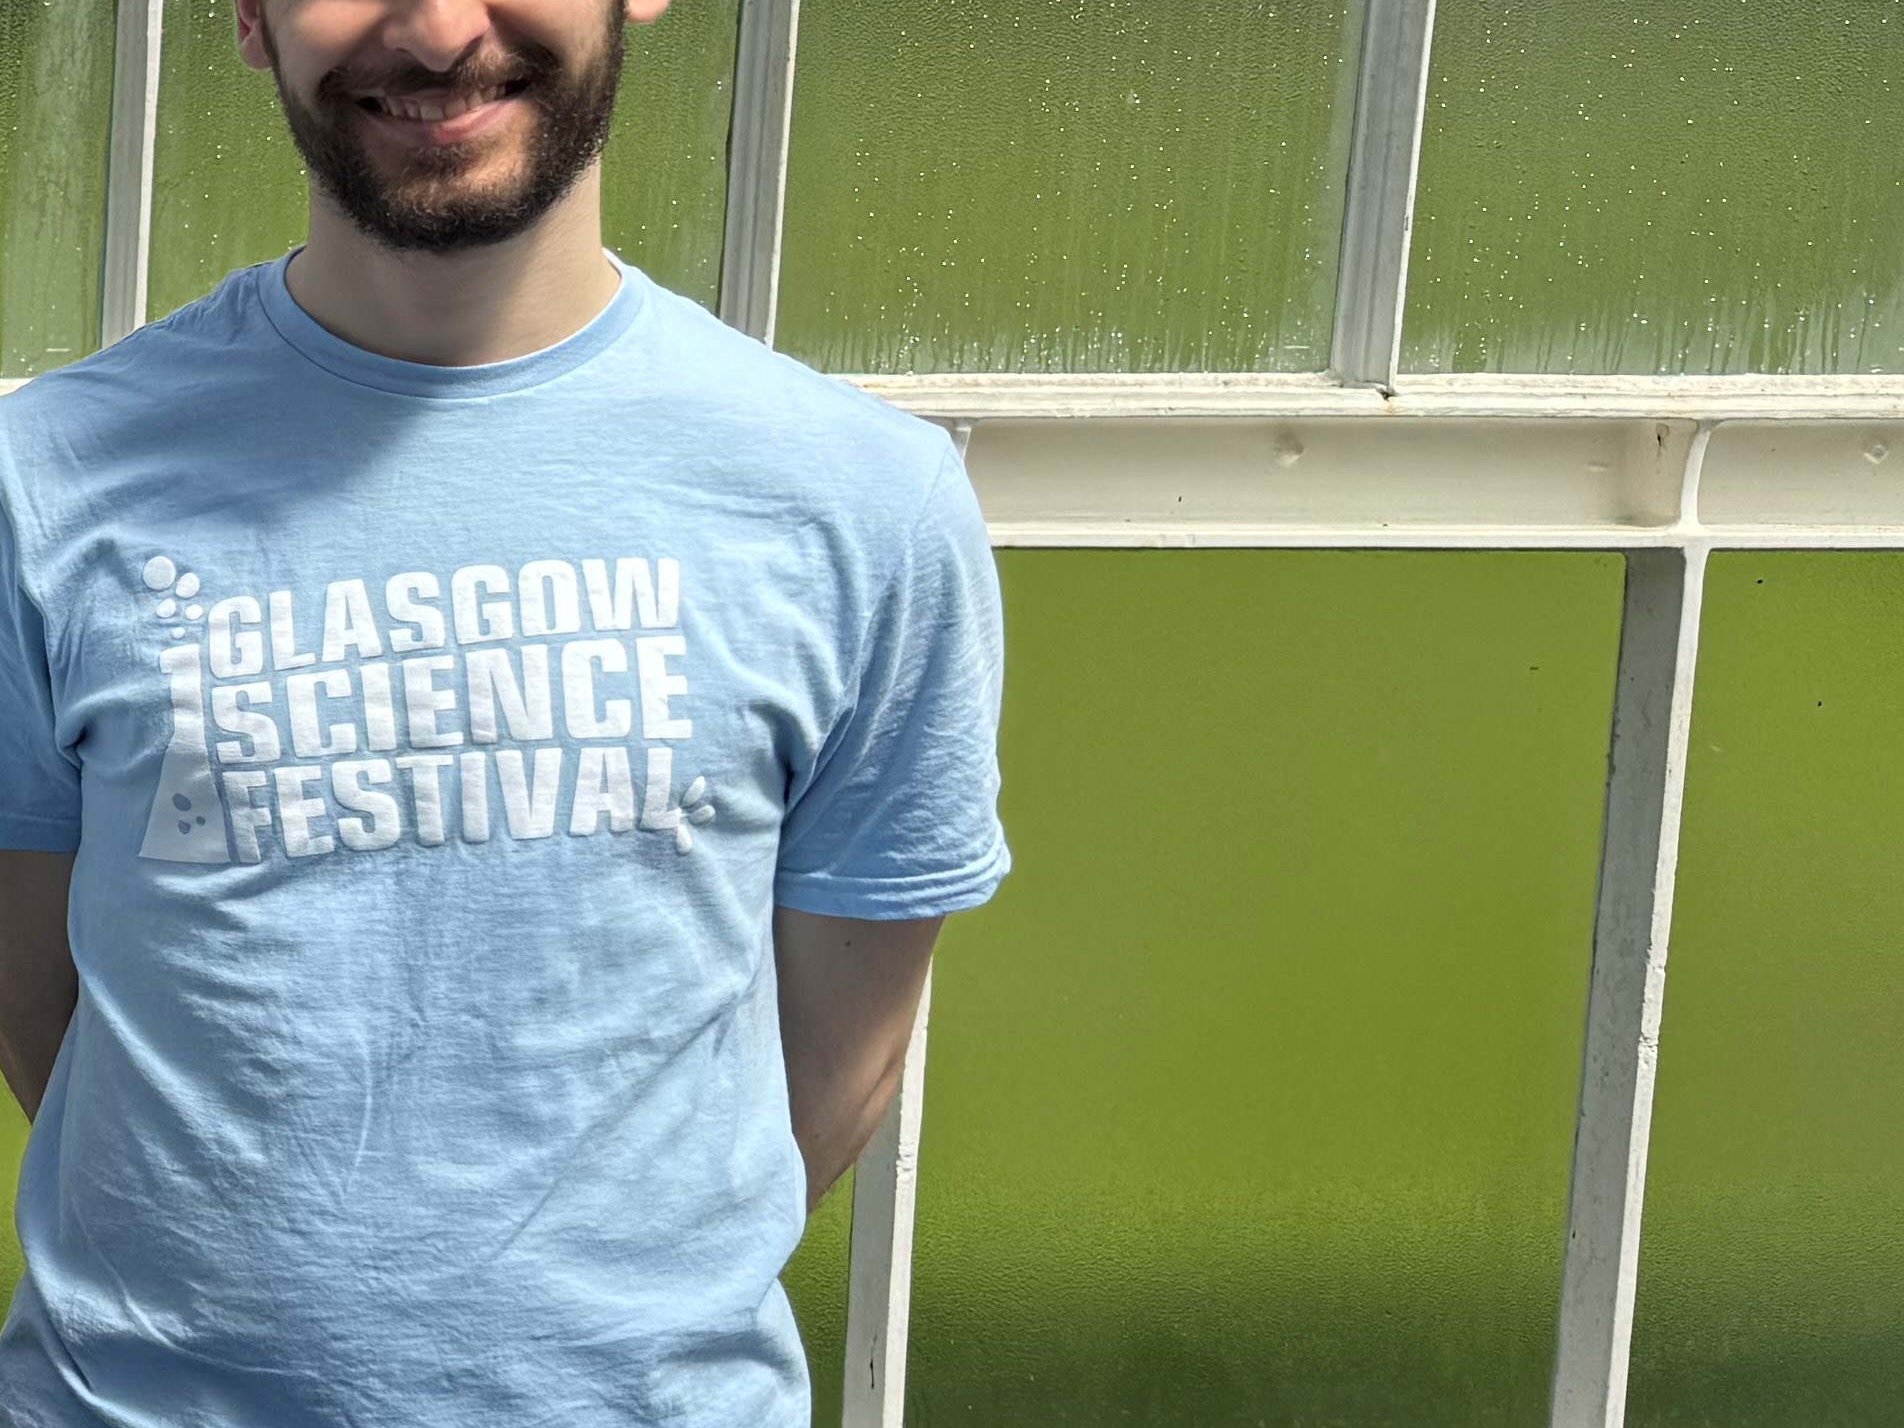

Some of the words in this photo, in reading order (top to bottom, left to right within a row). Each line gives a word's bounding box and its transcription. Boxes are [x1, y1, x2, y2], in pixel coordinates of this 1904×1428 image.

[208, 557, 680, 679] GLASGOW
[210, 636, 693, 765] SCIENCE
[222, 747, 682, 864] FESTIVAL
